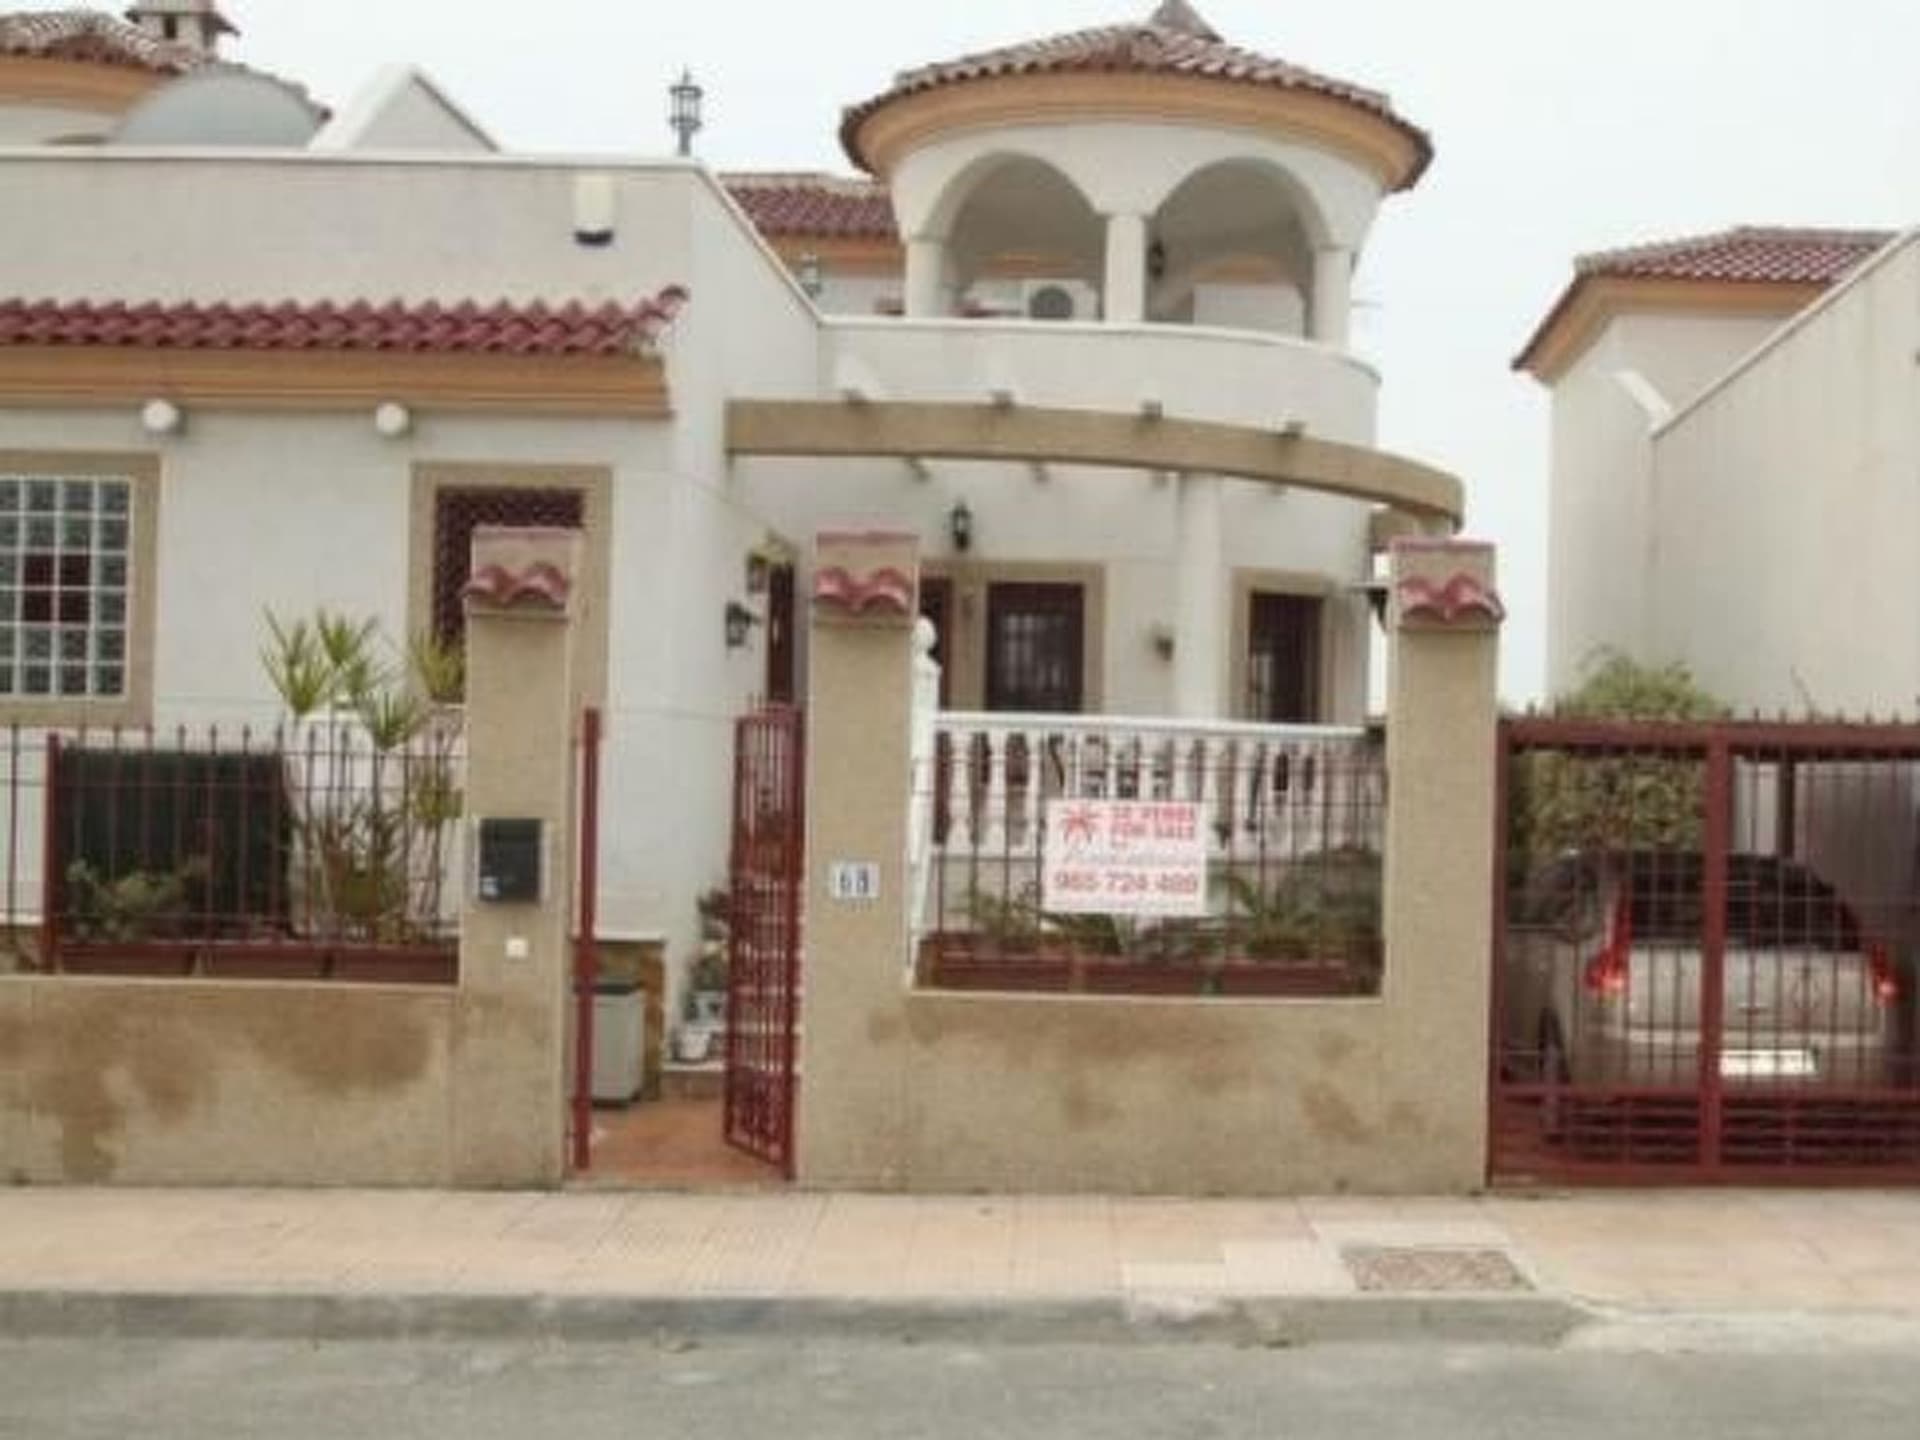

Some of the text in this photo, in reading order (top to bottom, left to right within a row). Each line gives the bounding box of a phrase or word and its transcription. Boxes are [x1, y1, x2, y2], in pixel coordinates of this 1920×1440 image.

[1110, 821, 1195, 839] FOR SALE
[1104, 870, 1149, 893] 724
